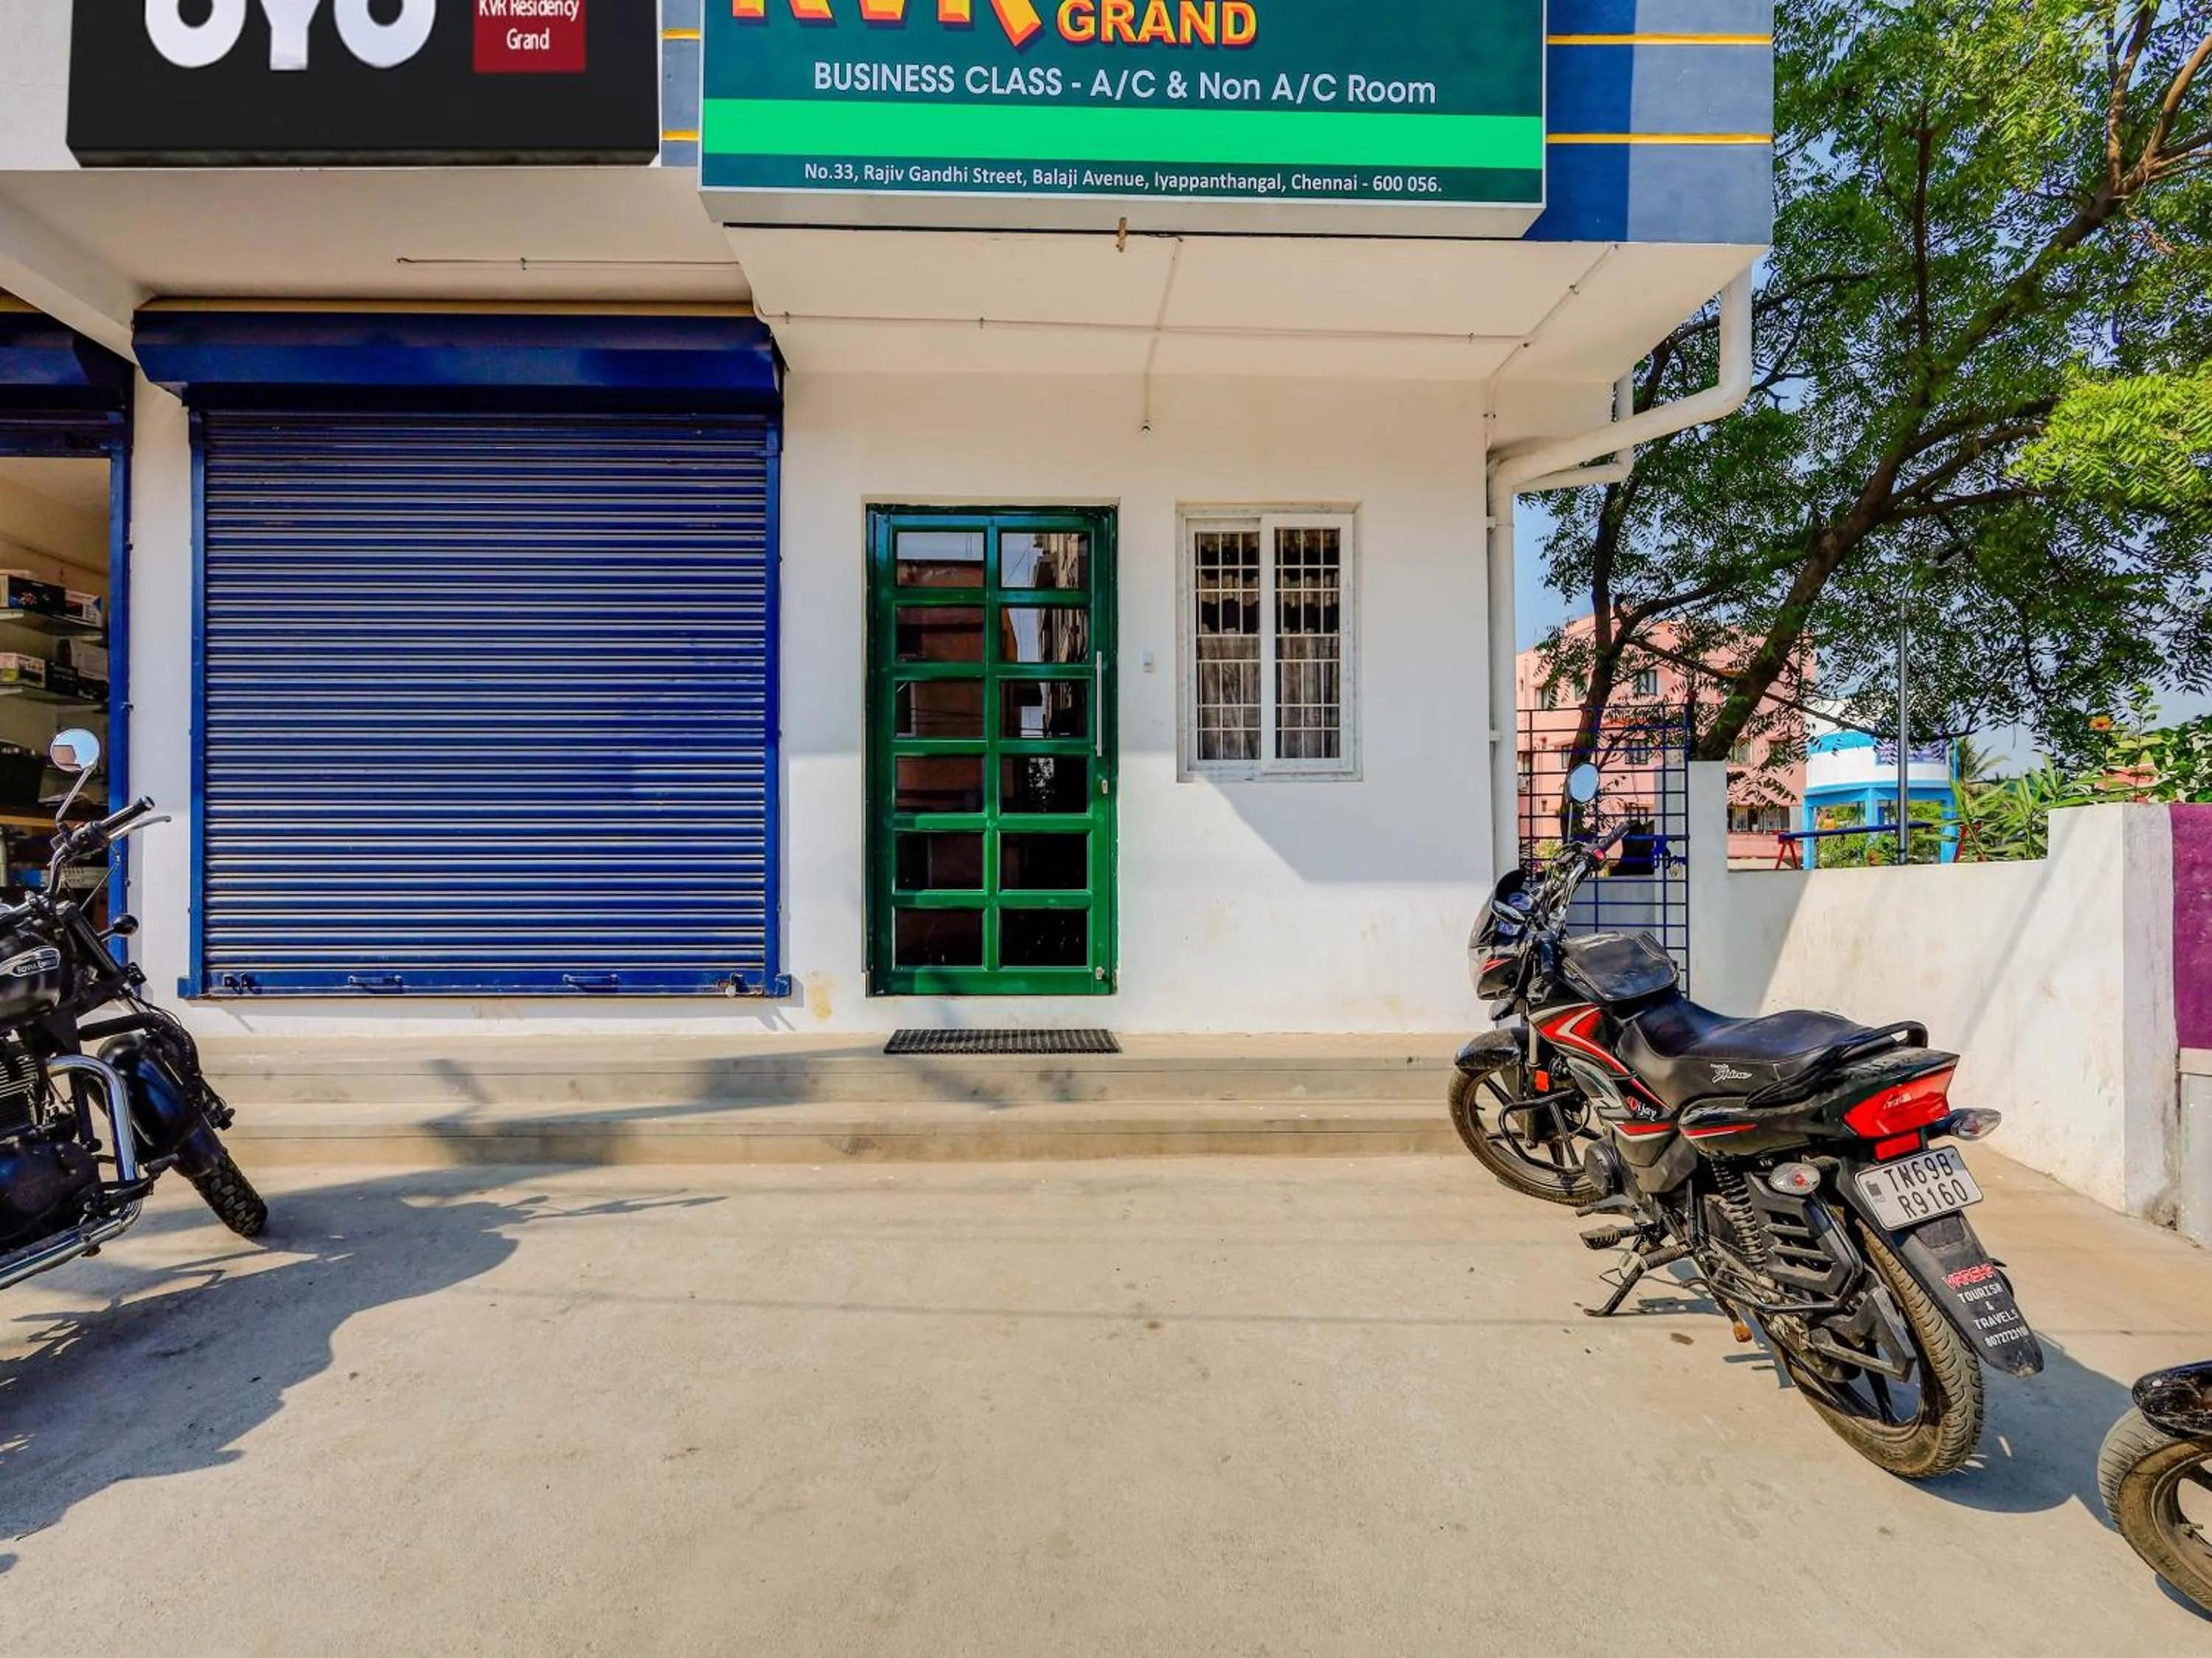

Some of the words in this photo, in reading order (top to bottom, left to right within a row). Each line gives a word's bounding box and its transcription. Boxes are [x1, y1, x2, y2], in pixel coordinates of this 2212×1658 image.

[510, 0, 580, 22] Residency
[1057, 0, 1256, 45] GRAND
[507, 27, 550, 50] Grand
[814, 62, 955, 94] BUSINESS
[965, 66, 1062, 97] CLASS
[1090, 69, 1156, 100] A/C
[1166, 72, 1188, 99] &
[1199, 72, 1260, 101] Non
[1271, 74, 1337, 105] A/C
[1348, 74, 1436, 104] Room
[804, 163, 858, 184] No.33,
[863, 164, 905, 185] Rajiv
[909, 165, 968, 184] Gandhi
[973, 167, 1028, 188] Street,
[1033, 169, 1078, 189] Balaji
[1082, 170, 1150, 189] Avenue,
[1155, 170, 1286, 193] Iyappanthangal,
[1291, 173, 1357, 192] Chennai
[1372, 176, 1403, 192] 600
[1408, 176, 1442, 192] 056.
[1884, 1152, 1953, 1193] TN69B
[1898, 1179, 1969, 1219] R9160
[1973, 1309, 2020, 1330] TRAVELS
